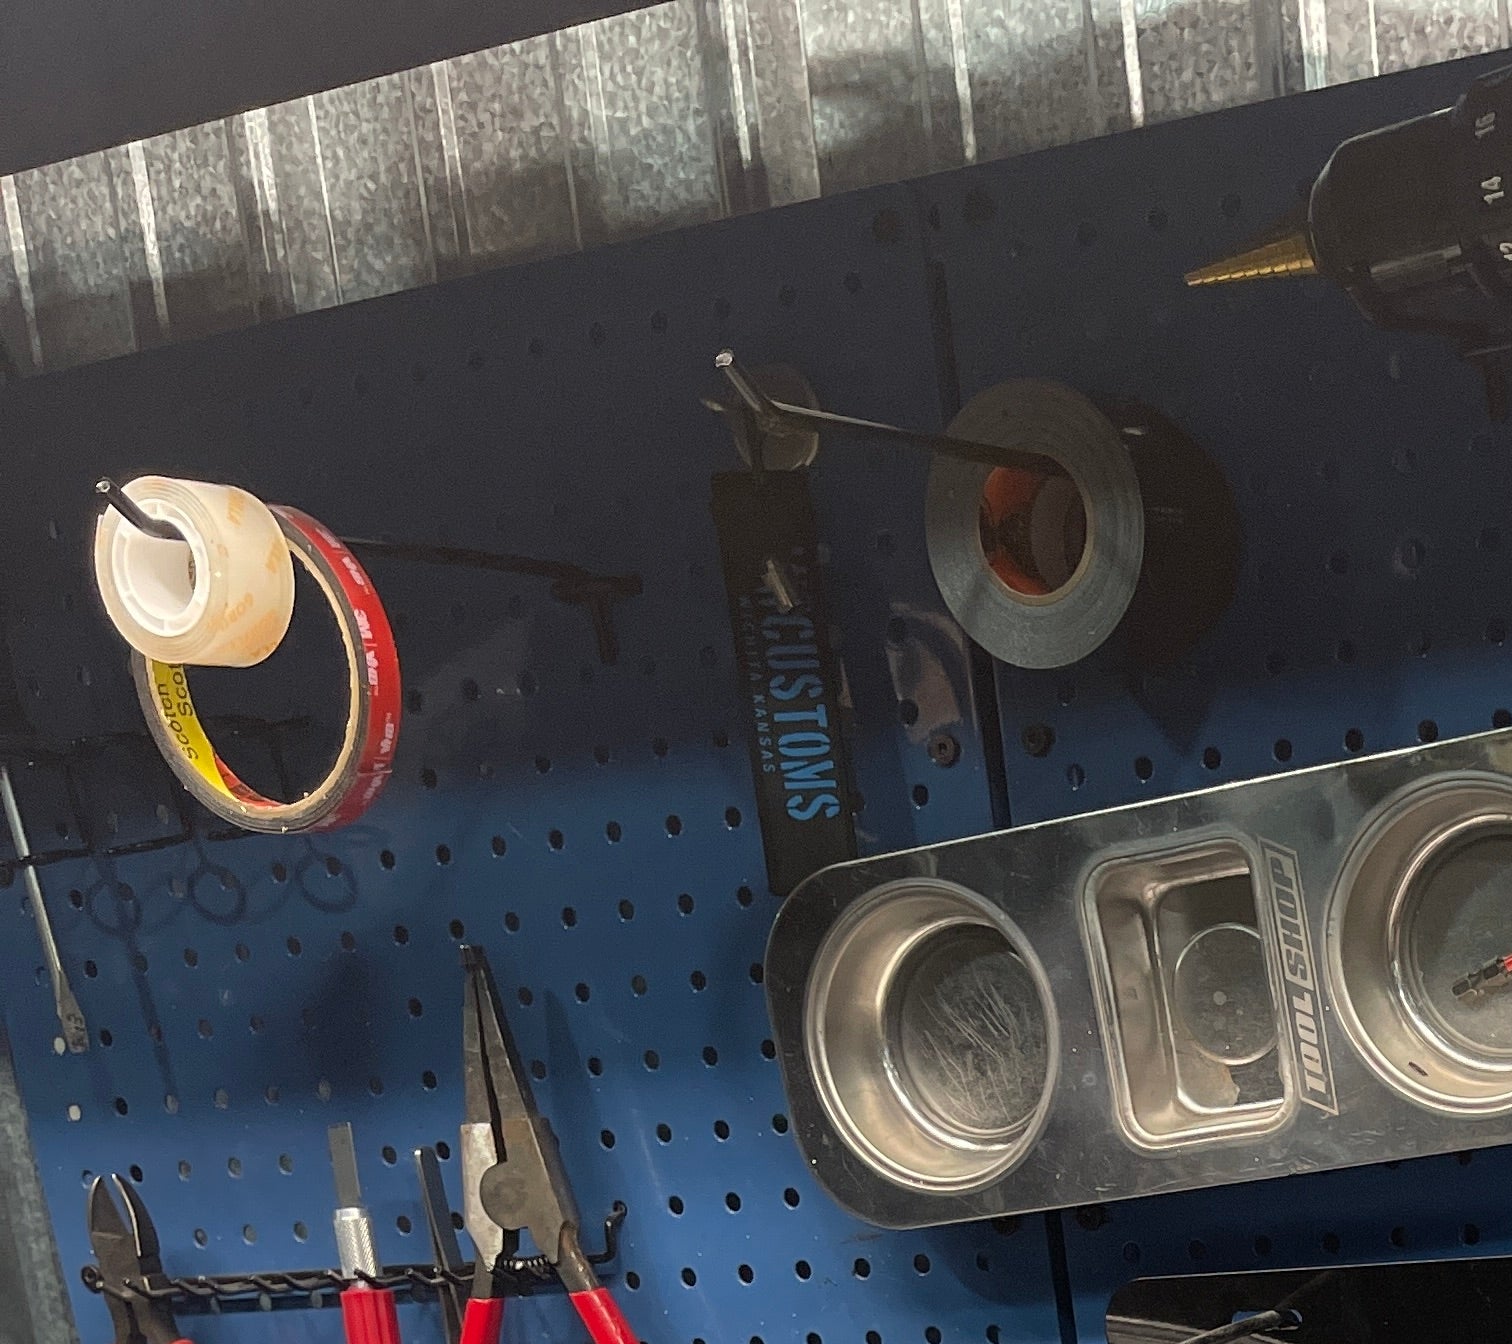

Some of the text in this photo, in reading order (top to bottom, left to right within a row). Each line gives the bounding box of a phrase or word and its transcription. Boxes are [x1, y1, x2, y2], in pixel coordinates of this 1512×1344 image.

[1480, 176, 1504, 204] 14
[752, 694, 775, 774] KANSAS
[758, 592, 840, 822] CUSTOMS
[1269, 855, 1328, 1095] TOOL SHOP
